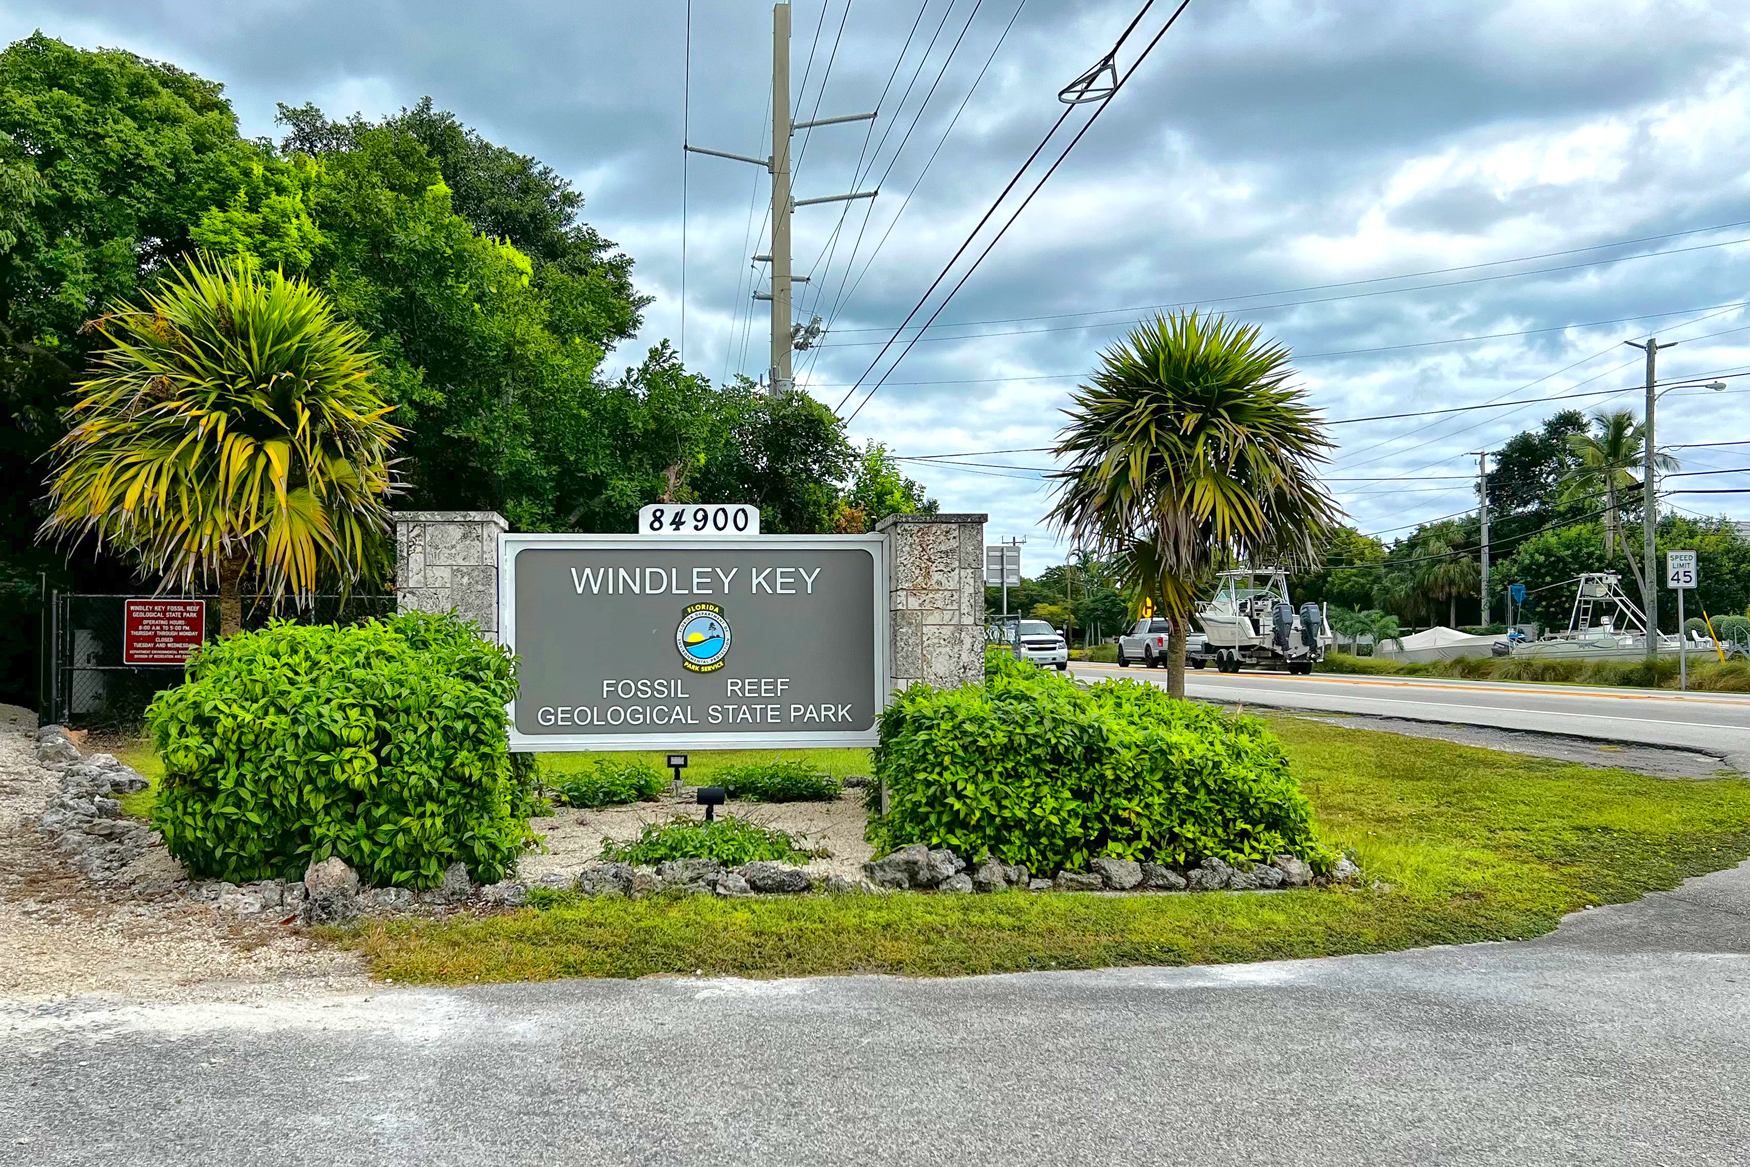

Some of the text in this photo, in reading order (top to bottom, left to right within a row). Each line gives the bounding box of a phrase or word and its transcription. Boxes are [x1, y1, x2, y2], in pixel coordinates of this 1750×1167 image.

[649, 507, 749, 532] 84900
[571, 566, 822, 595] WINDLEY KEY
[1670, 570, 1693, 584] 45
[687, 604, 719, 613] FLORIDA
[684, 661, 724, 672] PARK SERVICE
[602, 678, 790, 699] FOSSIL REEF
[537, 703, 853, 726] GEOLOGICAL STATE PARK
